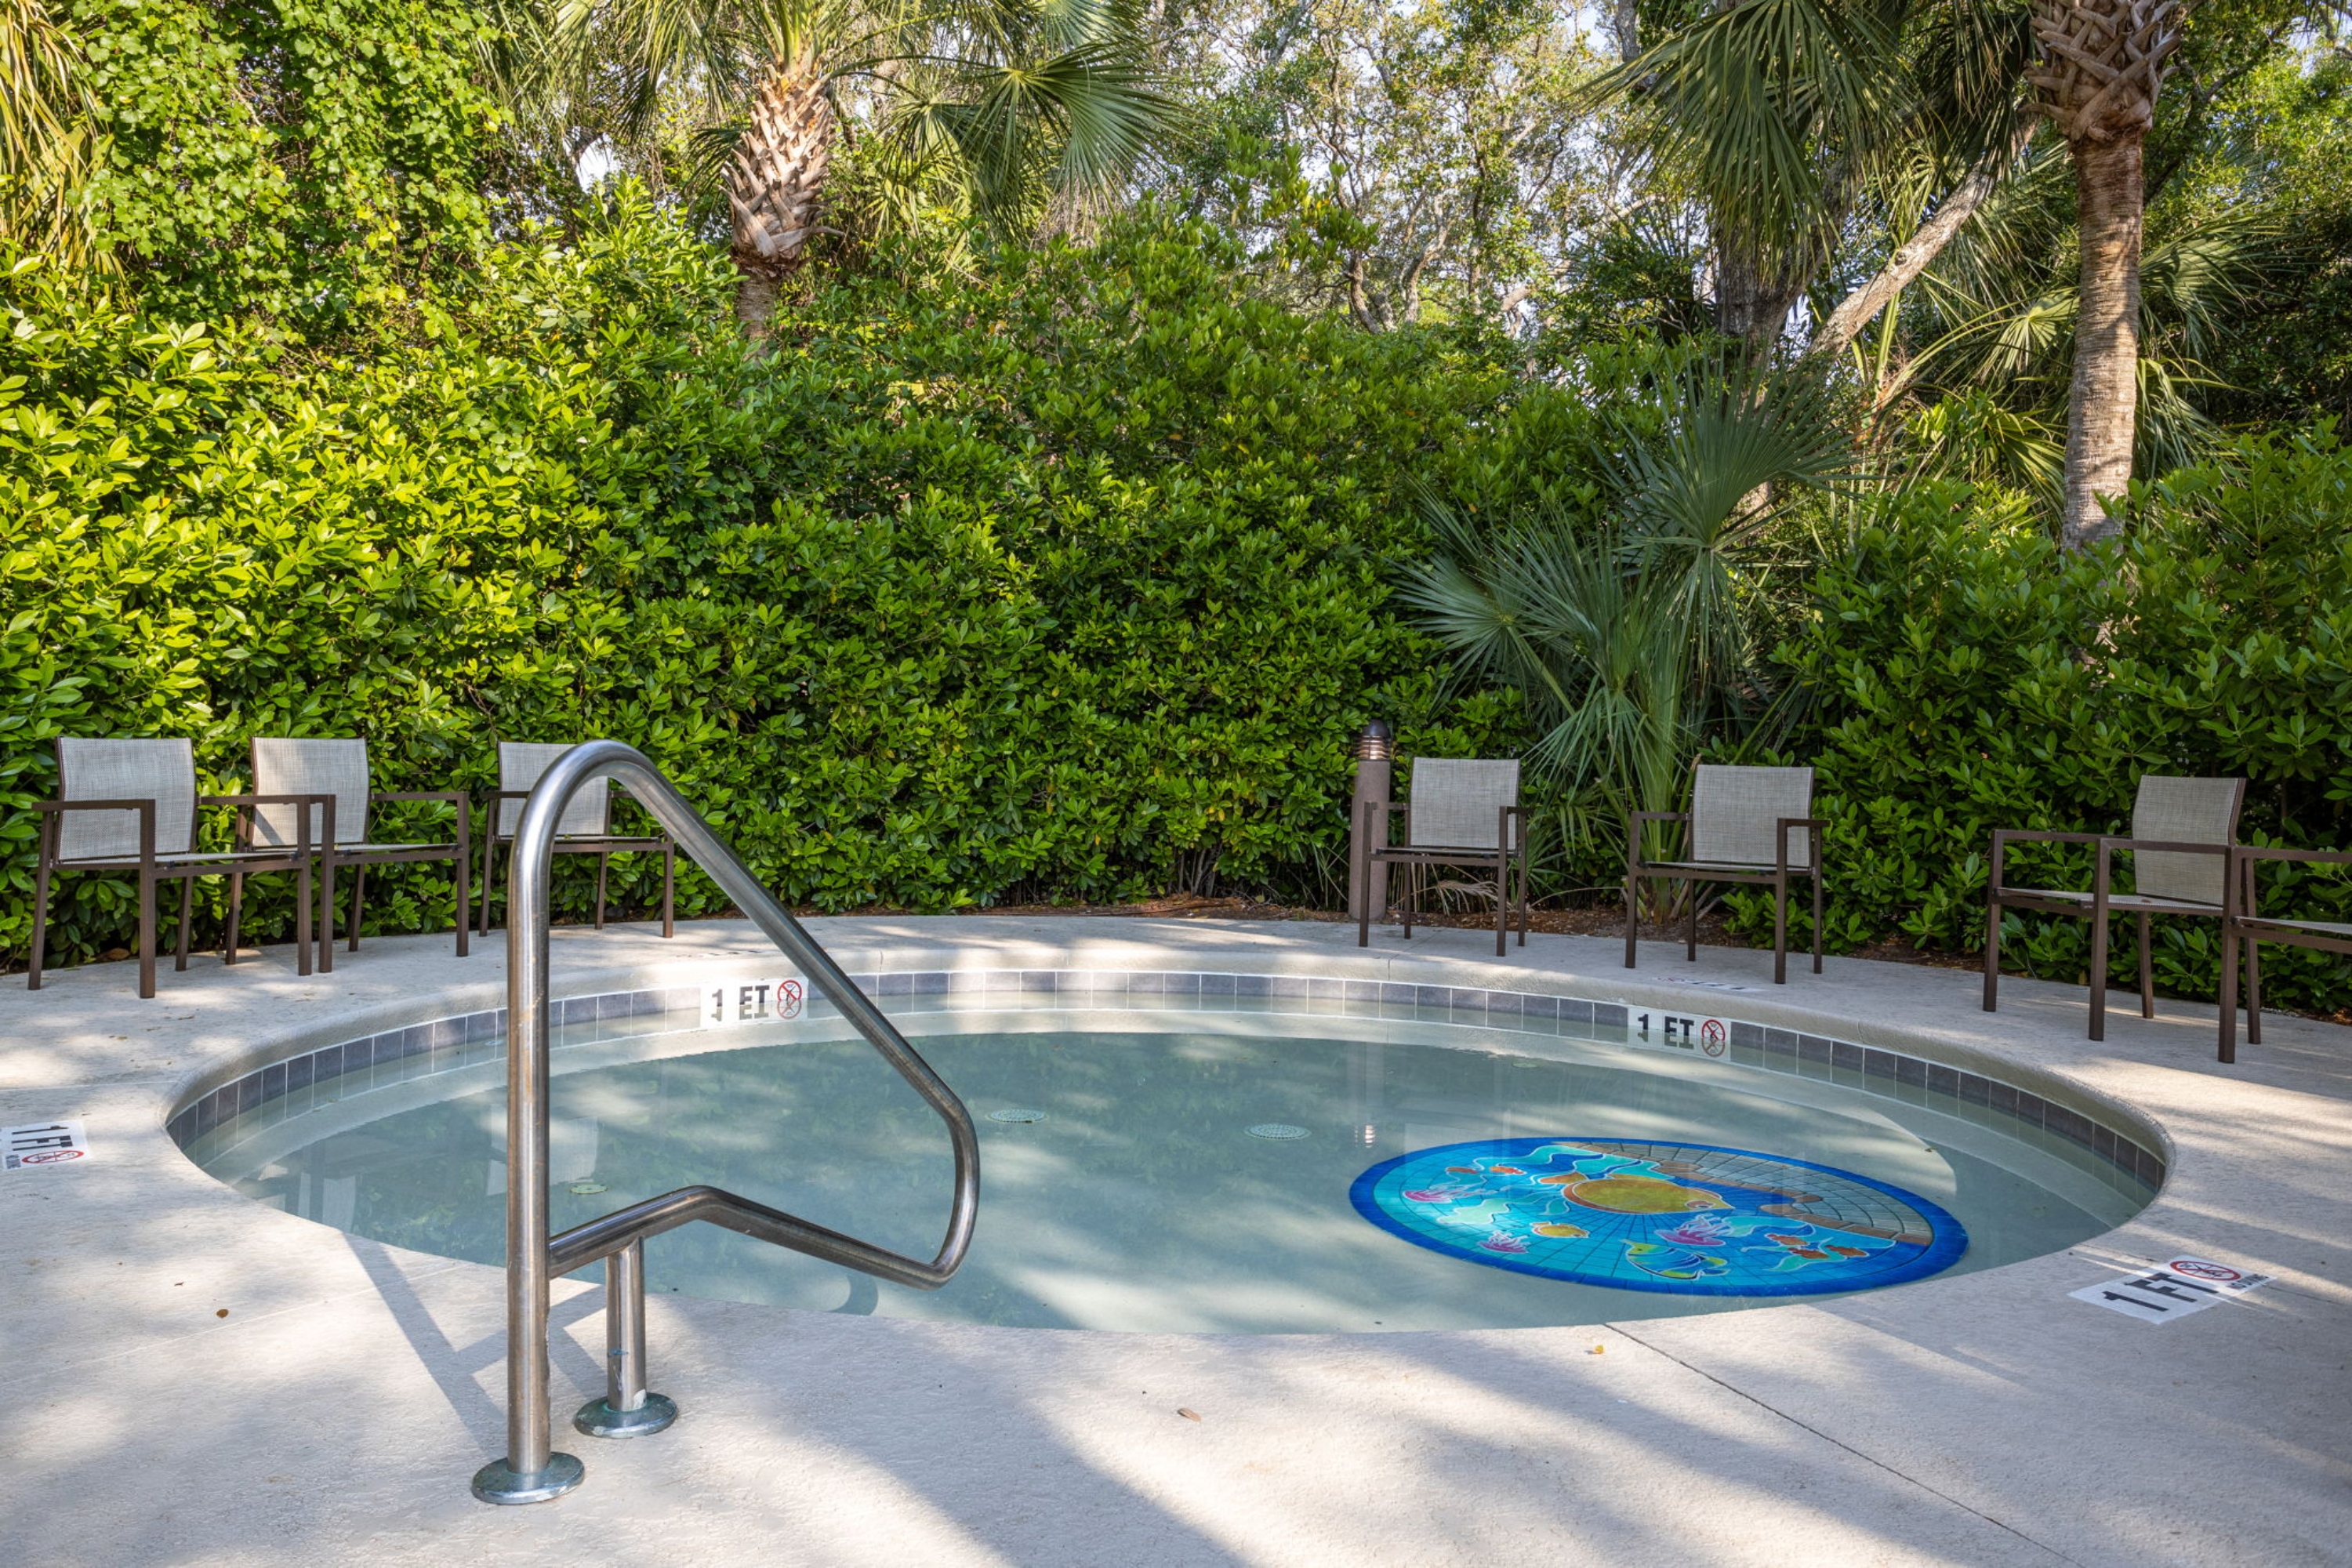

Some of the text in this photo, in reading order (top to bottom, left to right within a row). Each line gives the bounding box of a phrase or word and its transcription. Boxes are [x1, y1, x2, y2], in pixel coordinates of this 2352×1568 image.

[11, 1125, 73, 1152] 1 FT
[2102, 1290, 2169, 1312] 1
[2124, 1272, 2220, 1303] FT
